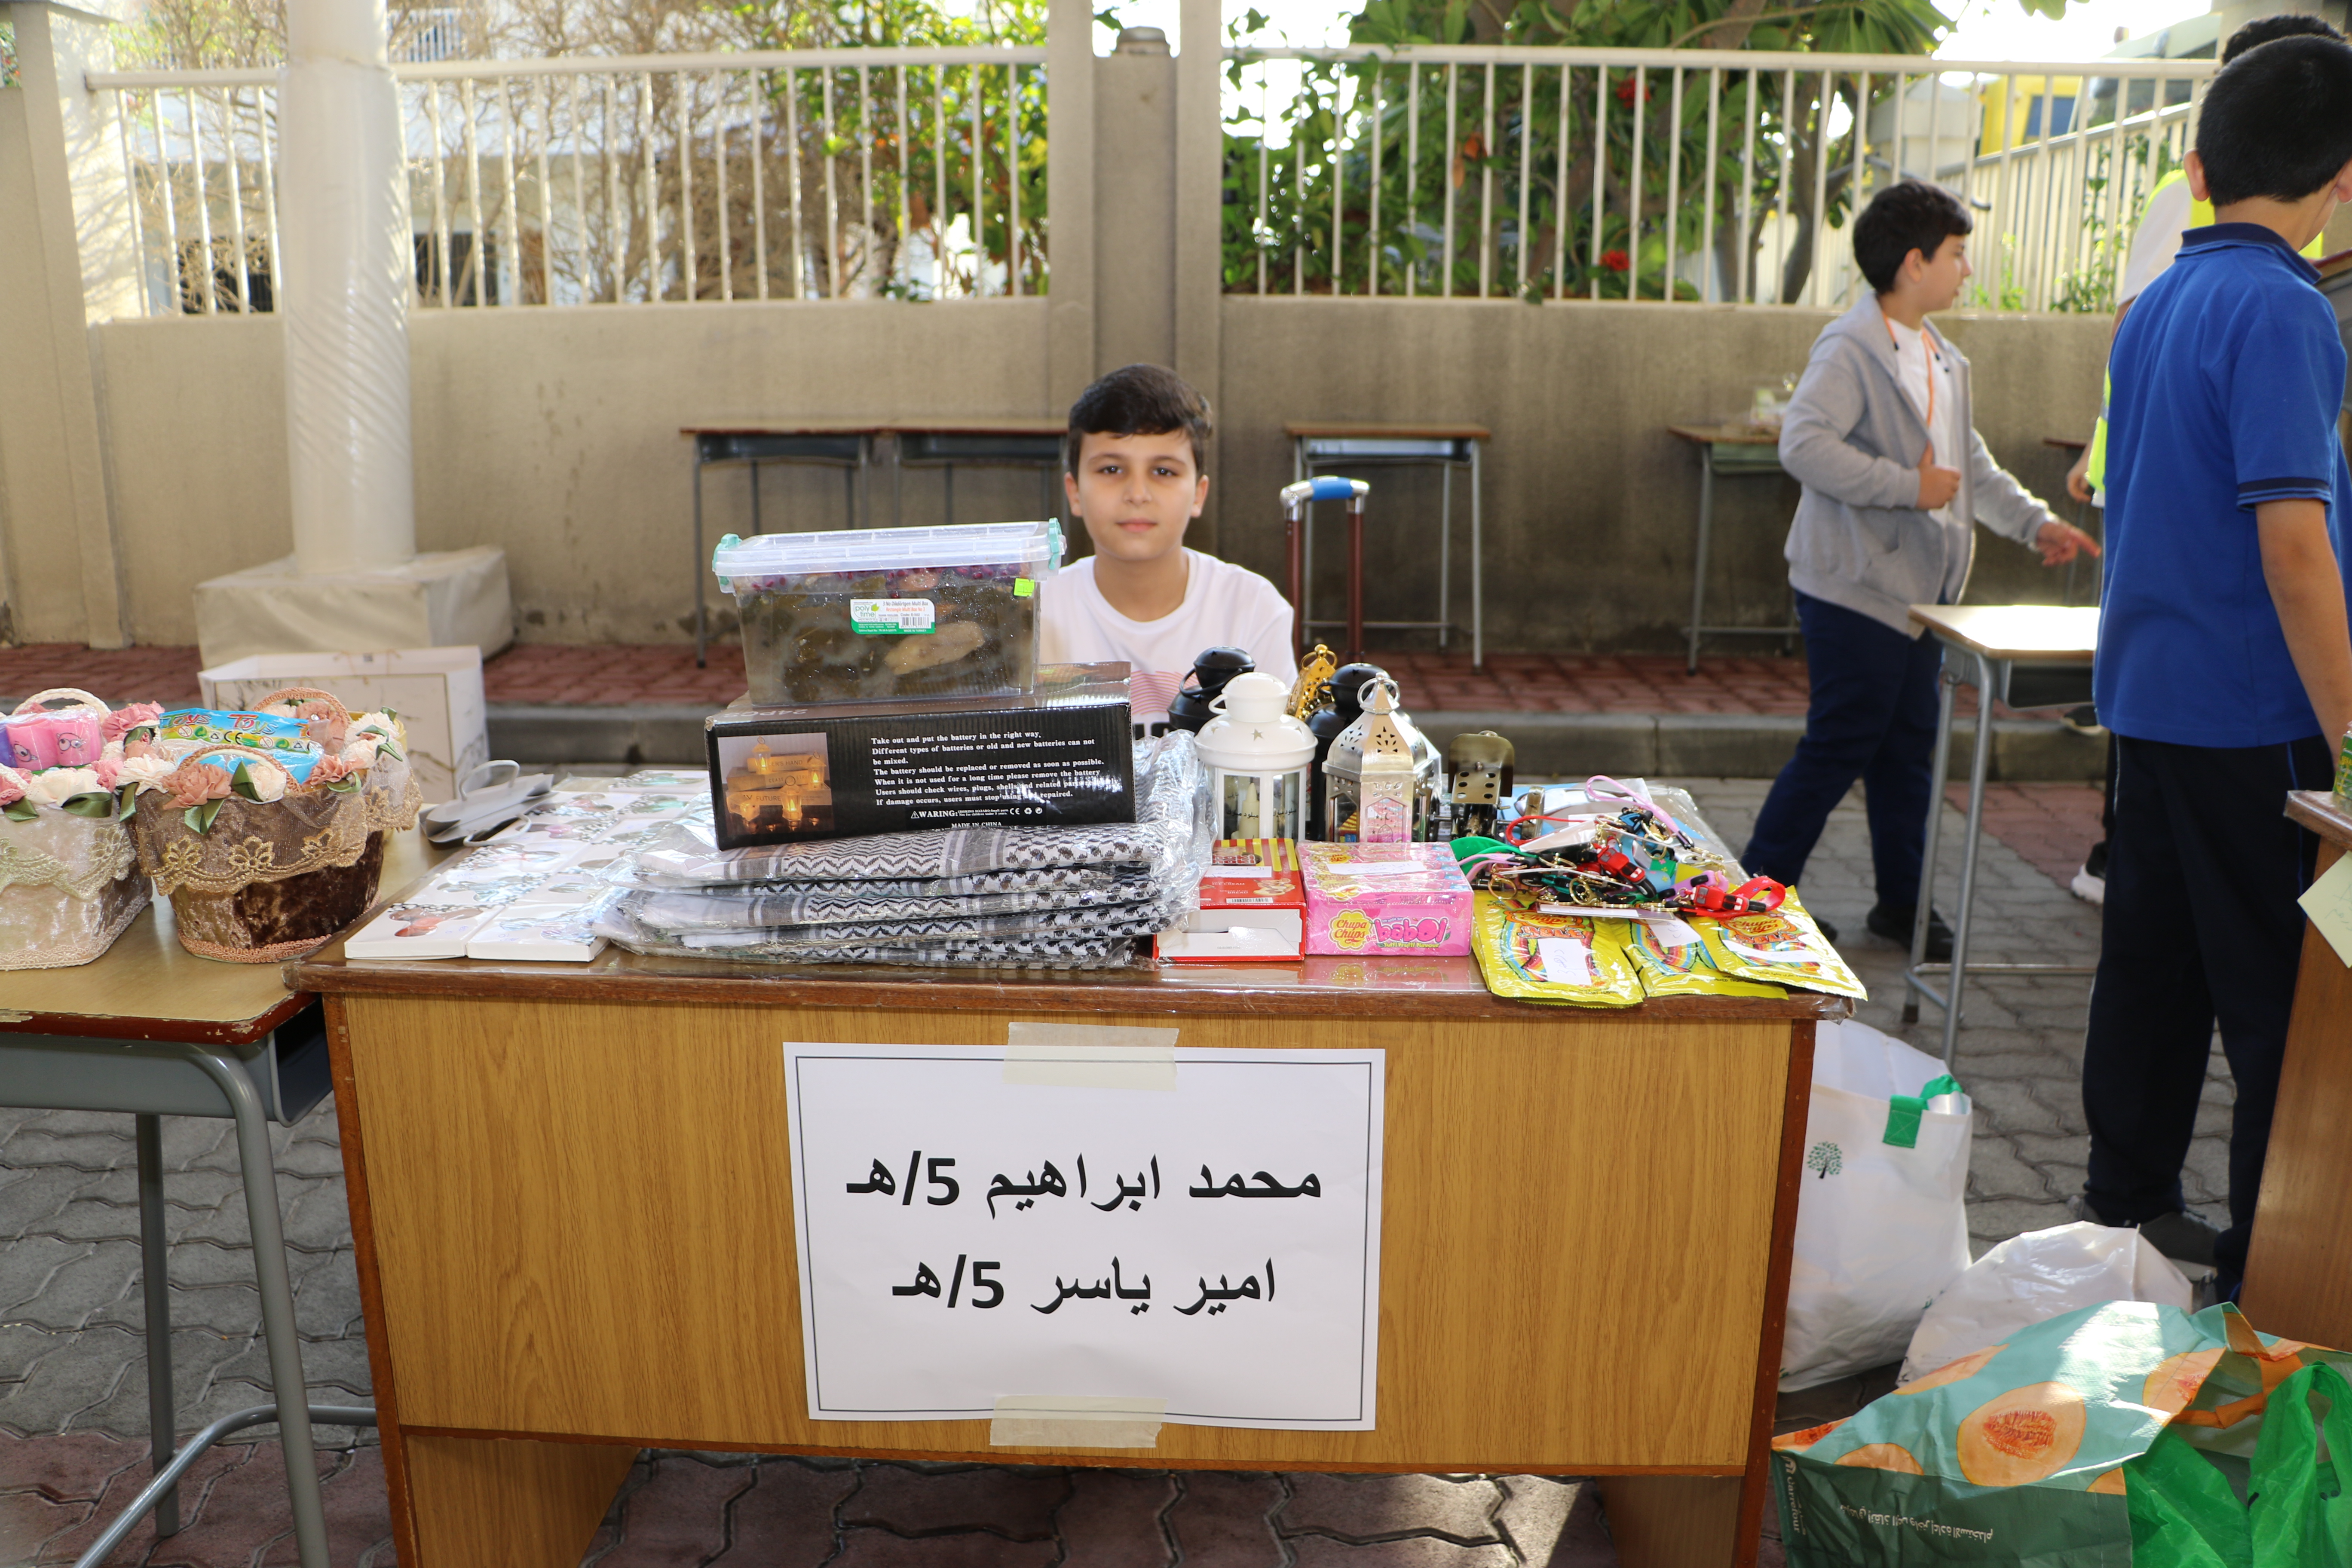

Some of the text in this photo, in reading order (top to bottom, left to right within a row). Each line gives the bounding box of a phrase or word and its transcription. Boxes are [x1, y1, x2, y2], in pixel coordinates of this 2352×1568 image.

[906, 735, 920, 743] and
[1003, 731, 1022, 739] right
[872, 747, 907, 755] Different
[942, 744, 974, 752] batteries
[1001, 741, 1014, 749] and
[1033, 739, 1066, 747] batteries
[884, 756, 909, 765] mixed.
[919, 766, 943, 774] should
[956, 763, 987, 773] replaced
[1000, 761, 1031, 769] removed
[1072, 758, 1104, 768] possible.
[1006, 772, 1029, 781] please
[971, 784, 994, 793] plugs,
[984, 795, 999, 803] stop
[1002, 793, 1022, 802] using
[1040, 790, 1073, 799] repaired.
[1336, 919, 1367, 931] Chupa
[1334, 928, 1366, 944] Chups
[986, 1153, 1160, 1219] ابراهيم
[1189, 1164, 1321, 1198] محمد
[1030, 1256, 1151, 1315] ياسر
[1173, 1258, 1275, 1316] امير
[1787, 1476, 1800, 1533] Carrefour
[1931, 1520, 1952, 1536] إعادة
[1953, 1527, 1993, 1543] الاستخدام
